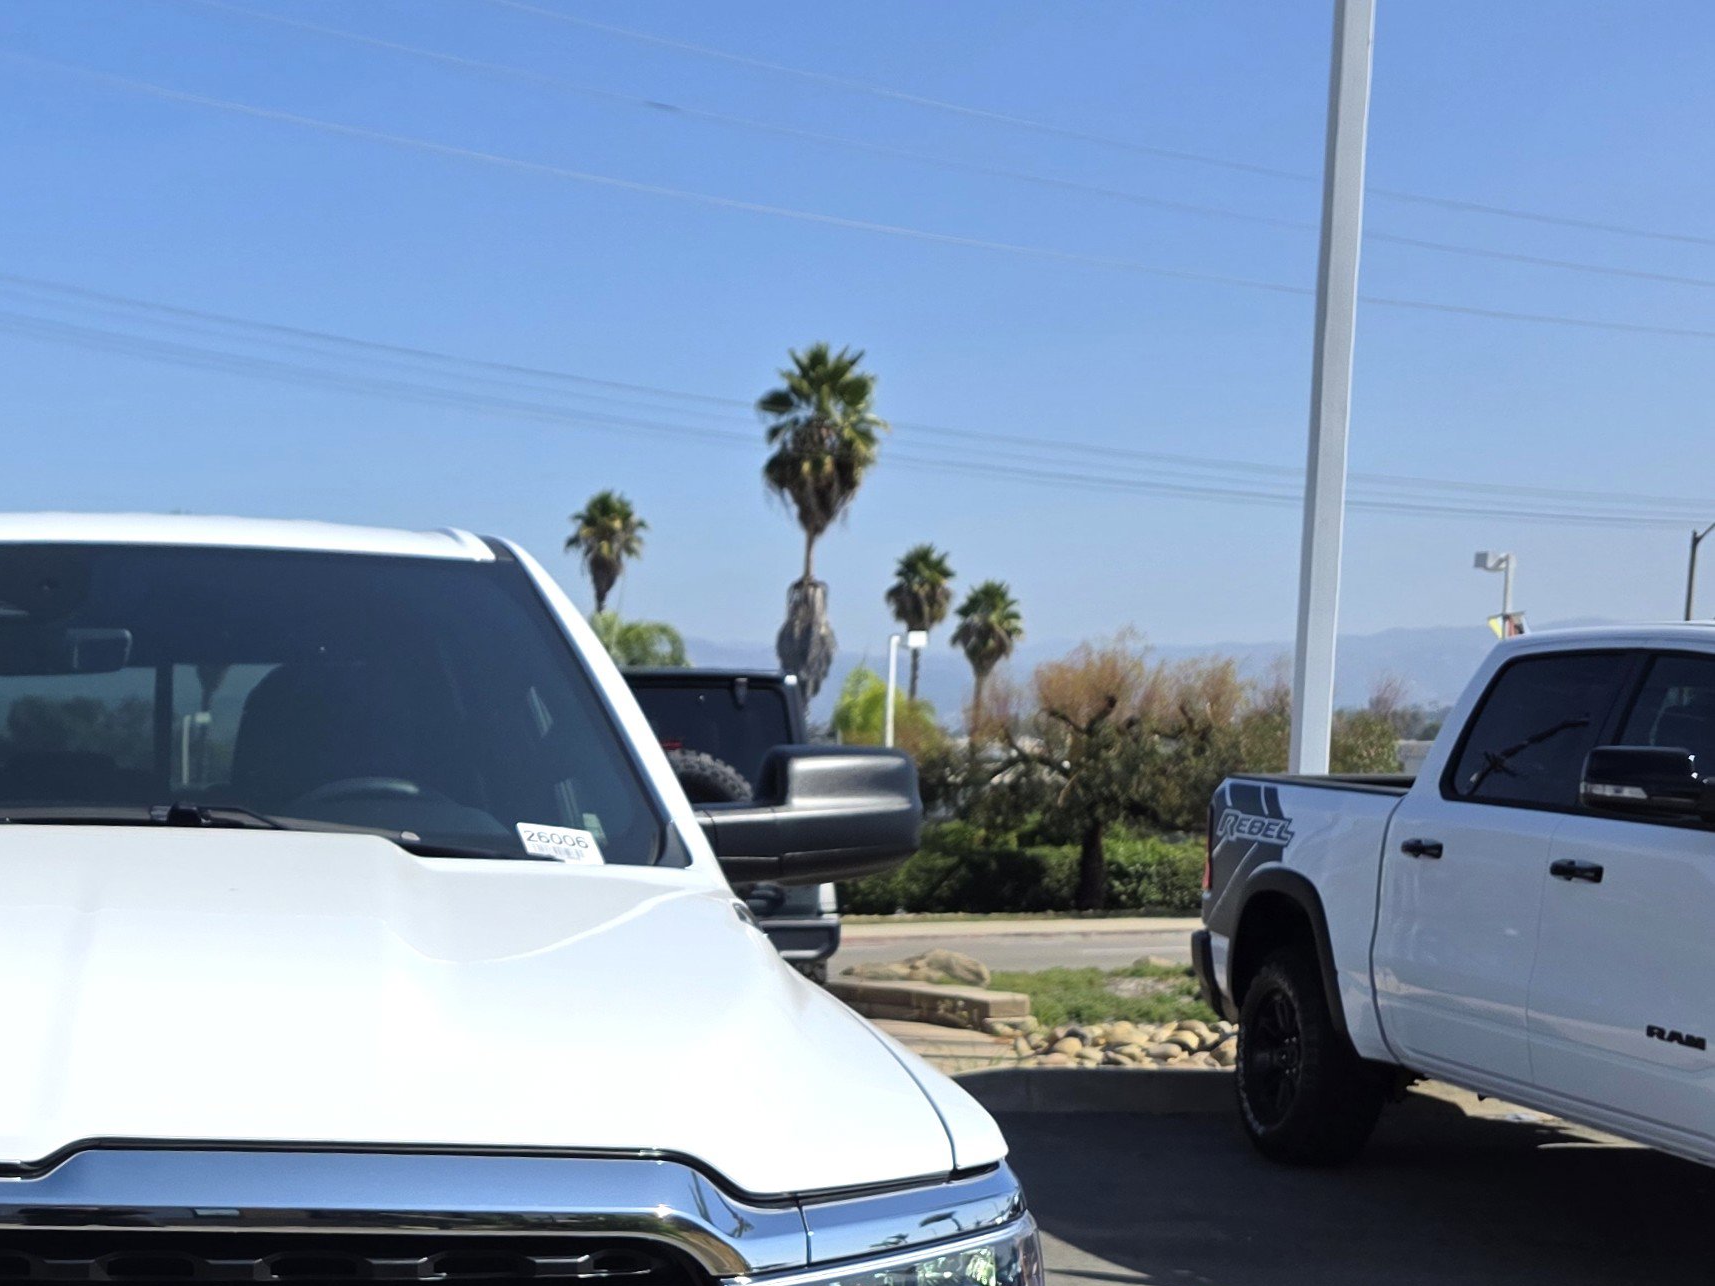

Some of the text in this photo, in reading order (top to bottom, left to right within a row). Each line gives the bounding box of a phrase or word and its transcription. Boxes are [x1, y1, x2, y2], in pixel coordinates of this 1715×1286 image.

[523, 830, 589, 849] 26006
[1217, 808, 1295, 847] REBEL
[1646, 1024, 1707, 1051] RAM
